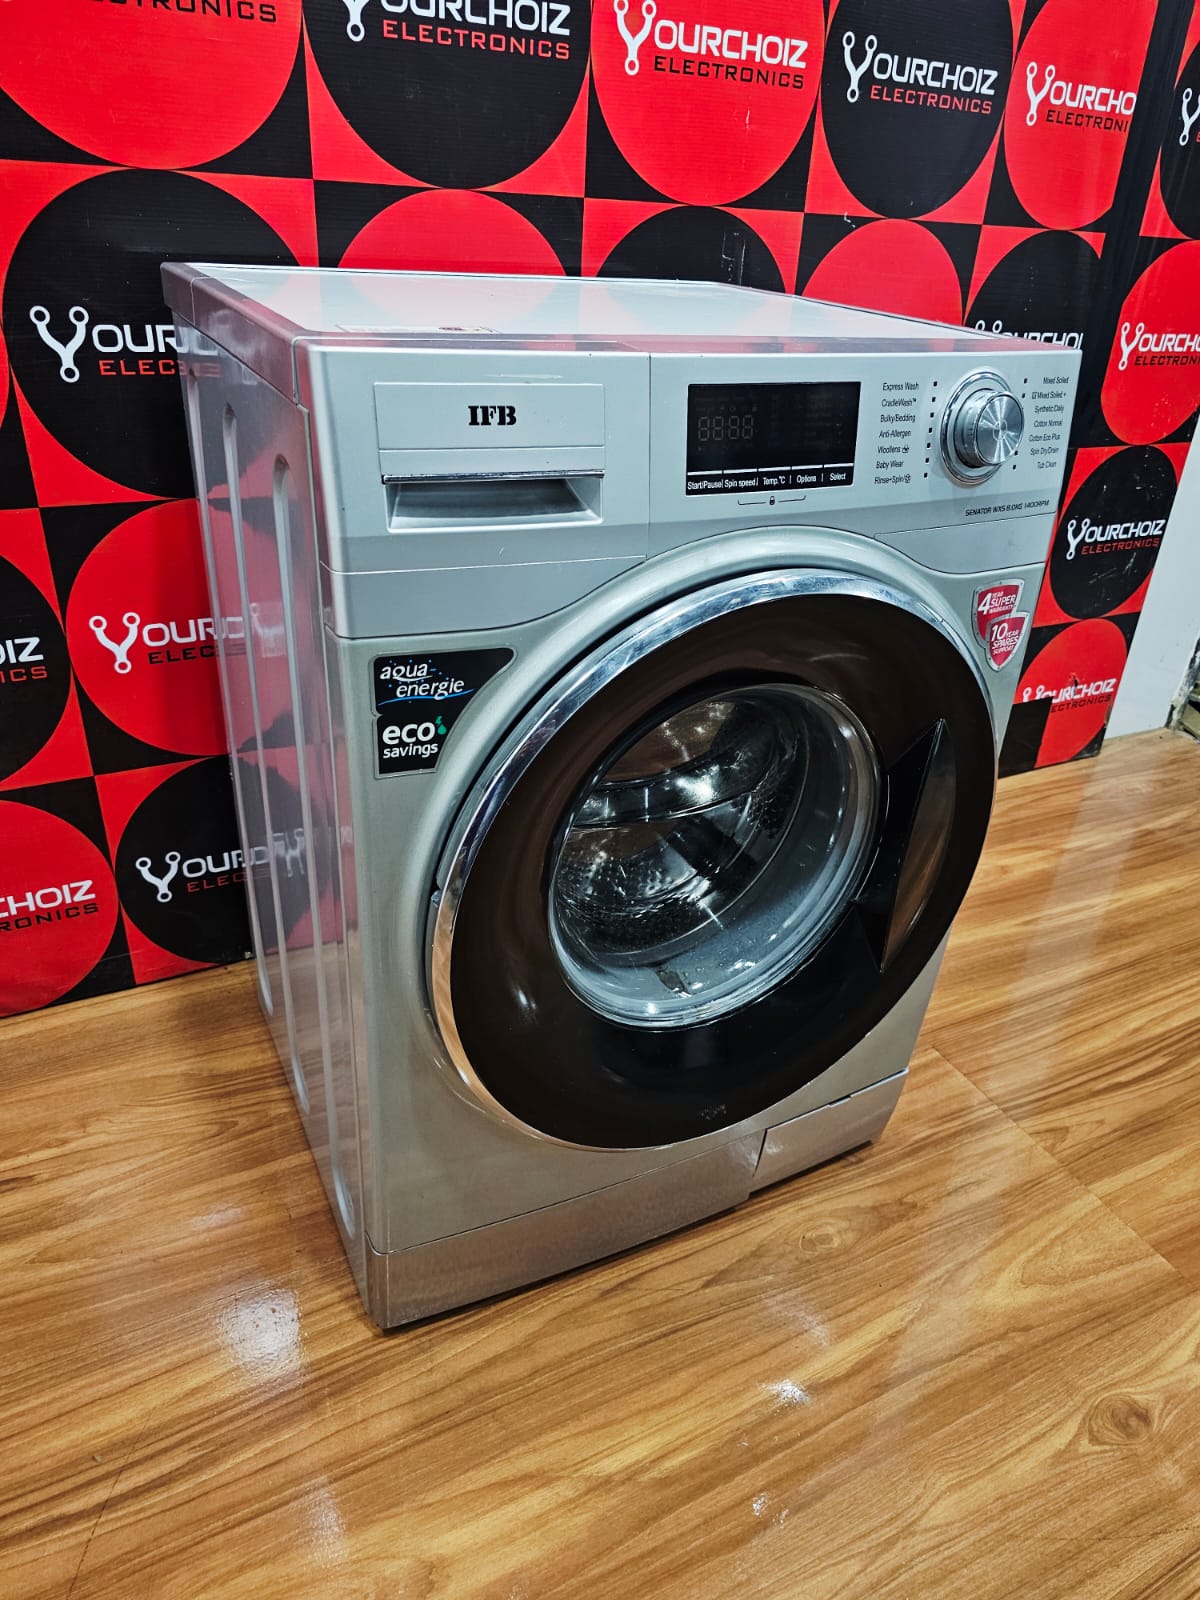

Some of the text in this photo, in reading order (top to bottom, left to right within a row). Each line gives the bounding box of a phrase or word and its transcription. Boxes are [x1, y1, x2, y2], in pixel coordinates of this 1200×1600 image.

[383, 19, 570, 60] ELECTRONICS
[654, 55, 804, 90] ELECTRONICS
[870, 85, 993, 115] ELECTRONICS
[1046, 109, 1129, 133] ELECTRONI
[882, 381, 920, 392] Express Wash
[468, 405, 517, 426] IFB
[879, 429, 912, 439] Anti-Allergen
[875, 459, 904, 470] Baby Wear
[724, 477, 756, 489] Spin speed
[796, 474, 817, 484] Options
[829, 472, 846, 481] Select
[965, 506, 992, 517] SENATOR
[1081, 537, 1160, 555] ELECTRONICS
[977, 592, 992, 615] 4
[990, 595, 1016, 608] SUPER
[991, 622, 1008, 642] 10
[0, 636, 44, 665] IZ
[379, 662, 432, 682] aqua
[395, 678, 465, 700] energie
[382, 721, 436, 745] eco
[383, 742, 438, 759] savings
